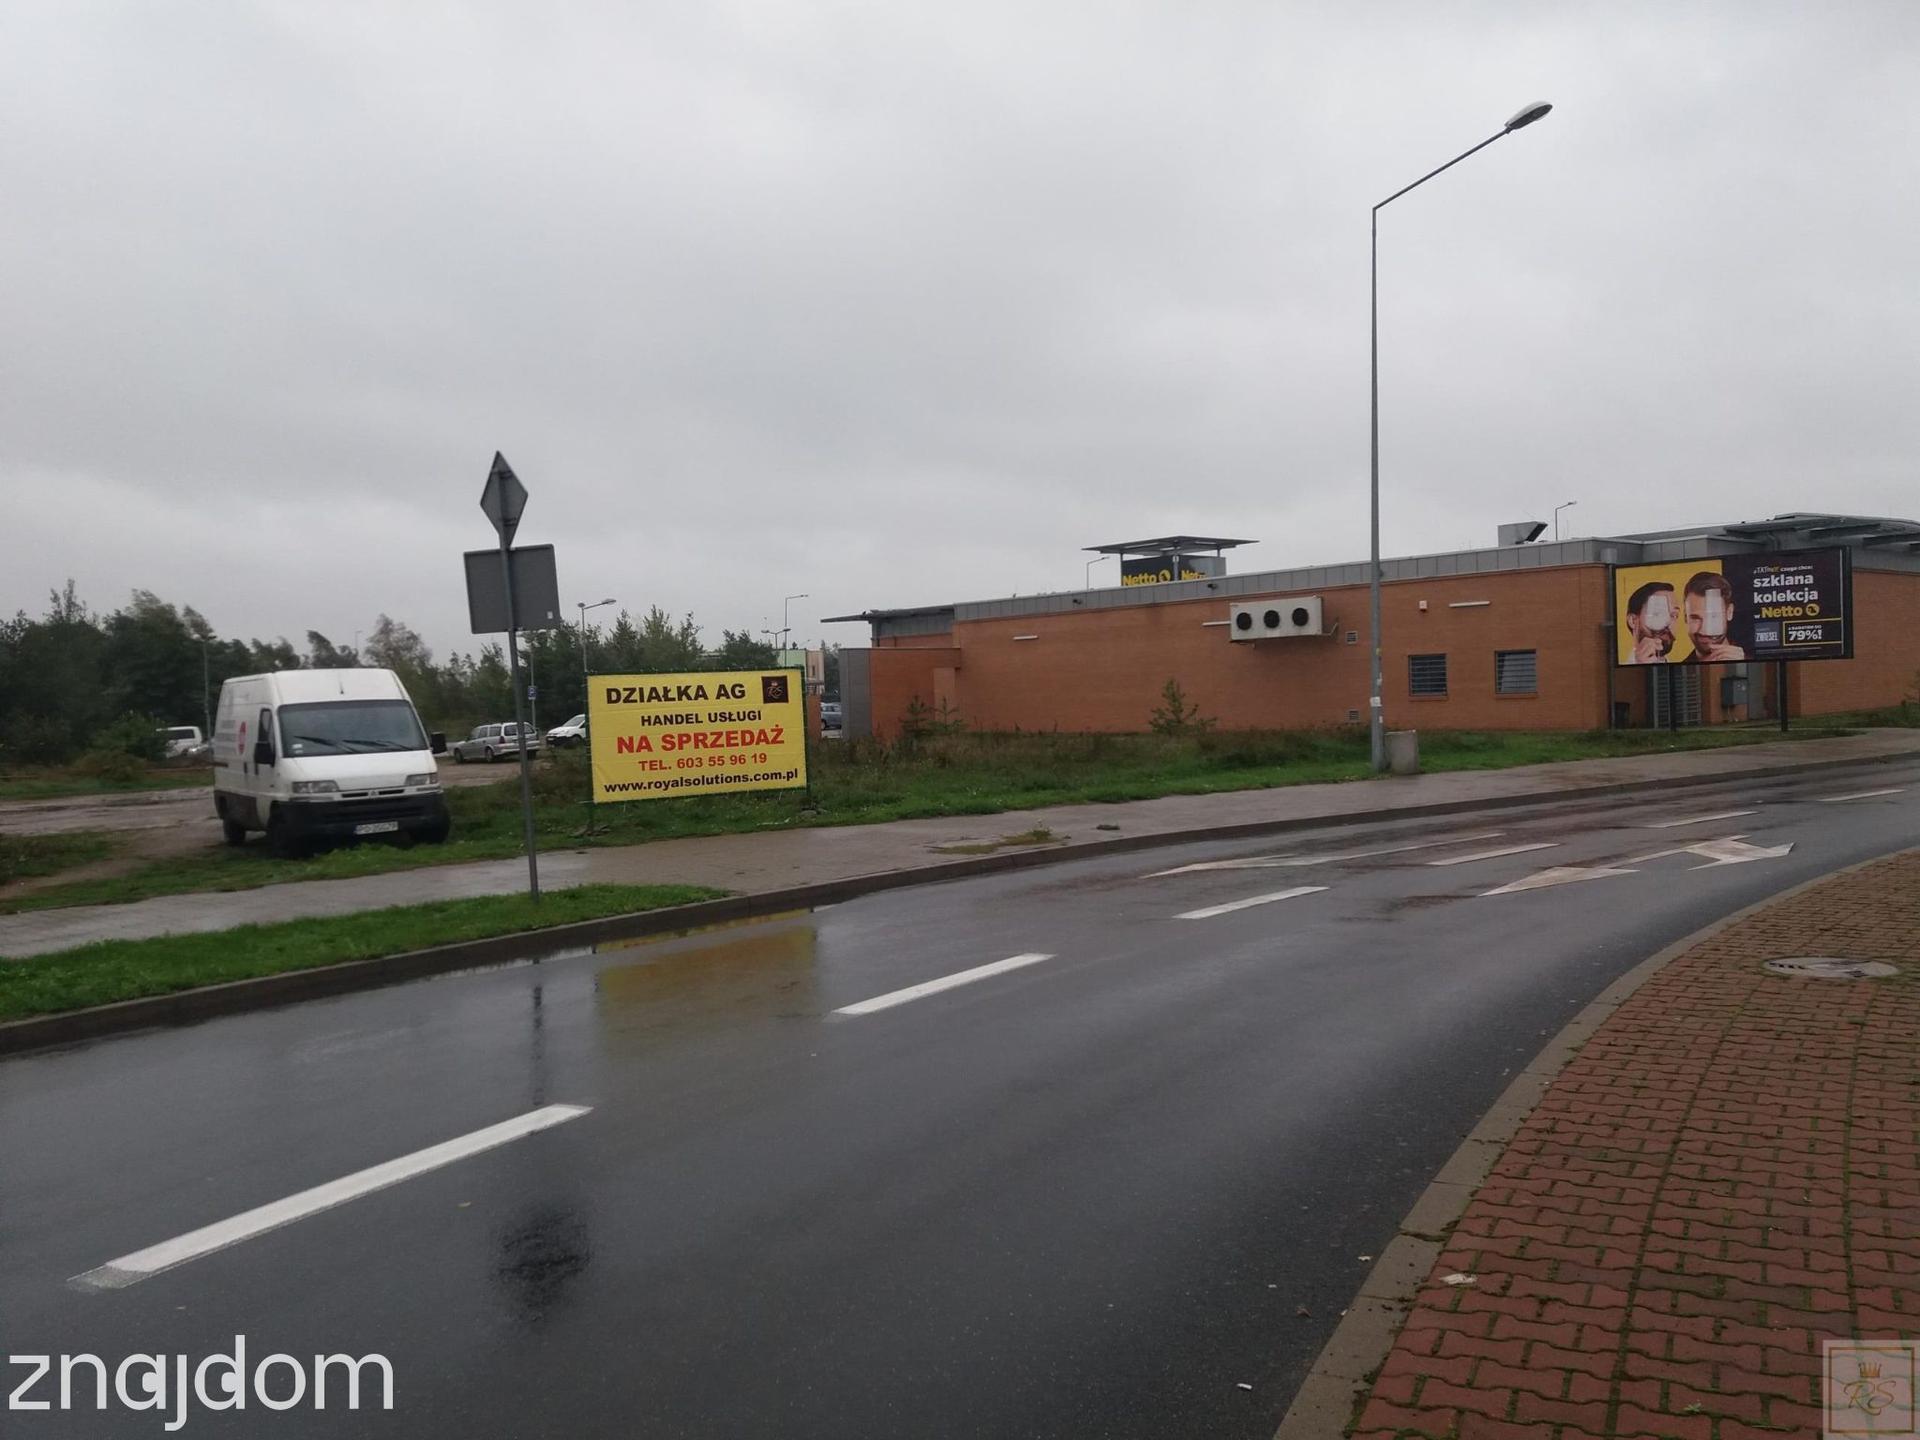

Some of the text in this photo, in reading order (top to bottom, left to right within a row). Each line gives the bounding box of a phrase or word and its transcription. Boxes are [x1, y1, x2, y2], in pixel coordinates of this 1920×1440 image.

[1123, 573, 1157, 586] Netto
[1753, 574, 1814, 588] szklana
[1753, 587, 1819, 604] kolekcja
[1761, 605, 1803, 618] Netto
[1788, 630, 1822, 641] 79%!
[606, 683, 746, 704] DZIAŁKA AG
[641, 710, 762, 727] HANDEL USŁUGI
[617, 724, 785, 754] NA SPRZEDAŻ
[638, 752, 768, 772] TEL. 603 55 96 19
[604, 768, 798, 793] www.royalsolutions.com.pl
